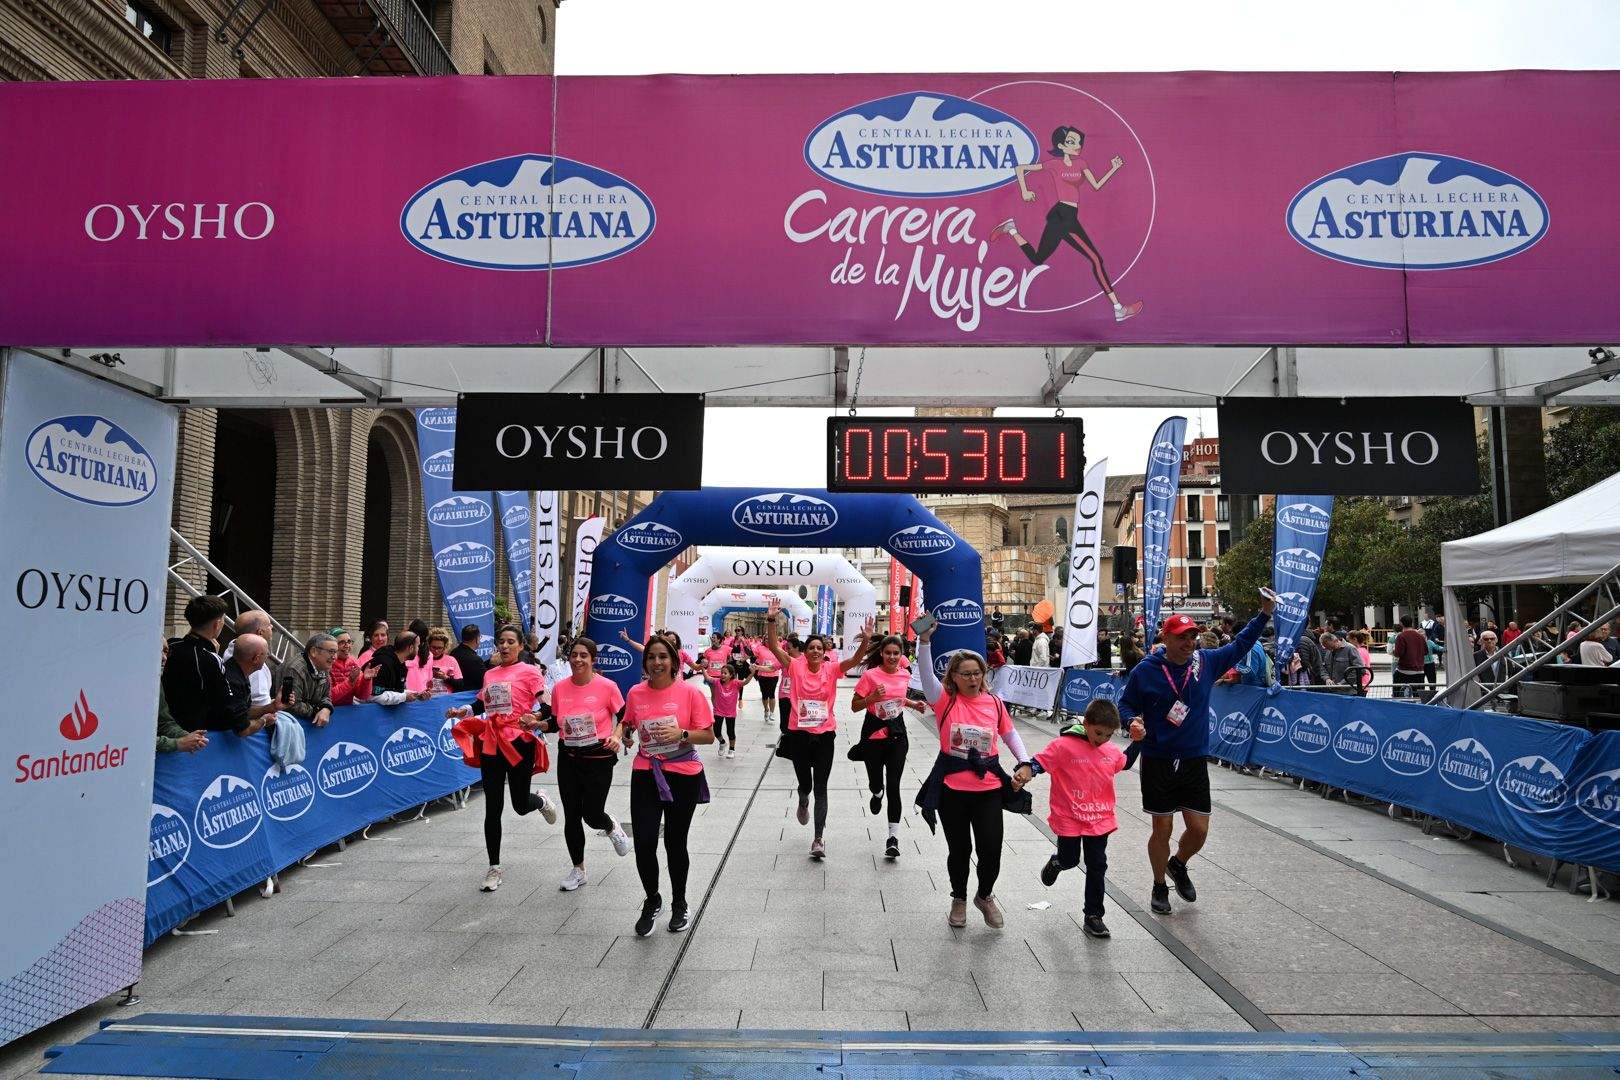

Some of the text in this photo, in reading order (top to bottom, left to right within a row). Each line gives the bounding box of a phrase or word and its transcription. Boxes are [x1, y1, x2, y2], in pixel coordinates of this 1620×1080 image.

[859, 128, 1014, 139] CENTRAL LECHERA
[822, 129, 1019, 170] ASTURIANA
[460, 193, 628, 206] CENTRAL LECHERA
[1346, 192, 1520, 204] CENTRAL LECHERA
[84, 201, 275, 242] OYSHO
[419, 197, 636, 240] ASTURIANA
[784, 189, 977, 245] Carrera
[1307, 196, 1531, 239] ASTURIANA
[830, 240, 1050, 332] de la Mujer
[60, 437, 148, 468] CENTRAL LECHERA
[495, 424, 668, 460] OYSHO
[1195, 443, 1220, 456] HOT
[1260, 430, 1439, 466] OYSHO
[35, 435, 149, 492] ASTURIANA
[739, 505, 830, 526] ASTURIANA
[620, 531, 677, 546] ASTURIANA
[894, 536, 952, 549] ASTURIANA
[537, 490, 559, 630] OYSHO
[732, 559, 814, 576] OYSHO
[1068, 490, 1100, 630] OYSHO
[17, 568, 149, 614] OYSHO
[1008, 669, 1049, 690] OYSHO
[1291, 726, 1327, 746] ASTURIANA
[1335, 733, 1375, 755] ASTURIANA
[14, 744, 129, 783] Santander
[387, 744, 433, 768] ASTURIANA
[1384, 742, 1431, 768] ASTURIANA
[322, 760, 375, 790] ASTURIANA
[265, 781, 313, 811] ASTURIANA
[202, 799, 261, 839] ASTURIANA
